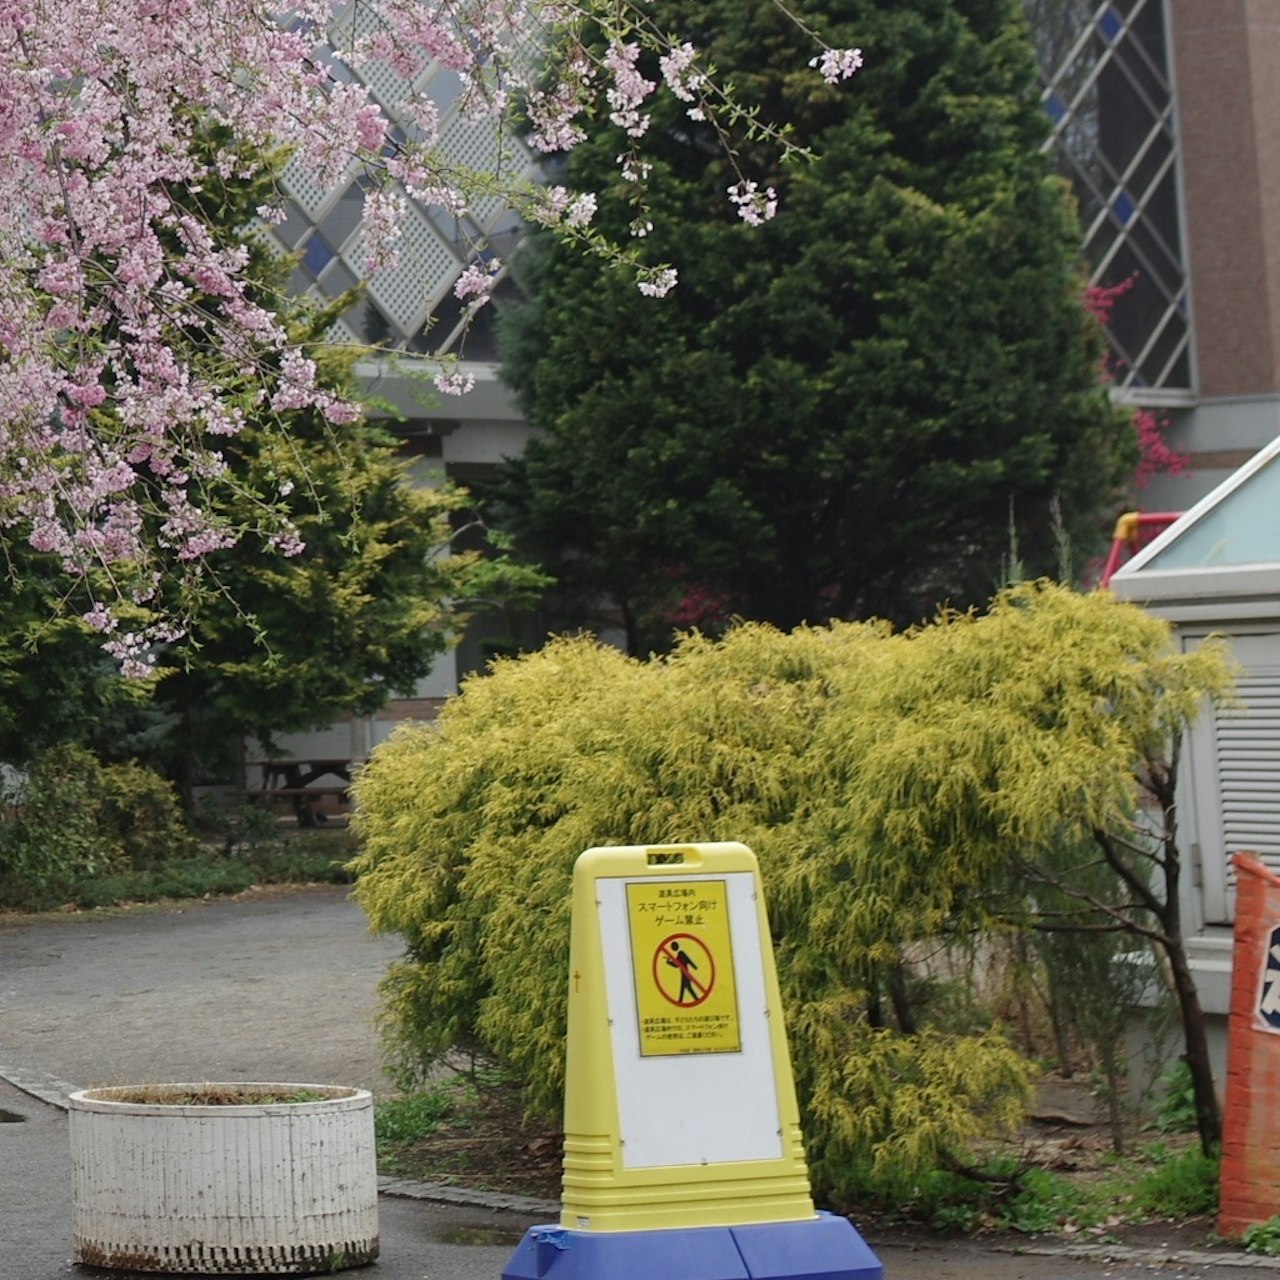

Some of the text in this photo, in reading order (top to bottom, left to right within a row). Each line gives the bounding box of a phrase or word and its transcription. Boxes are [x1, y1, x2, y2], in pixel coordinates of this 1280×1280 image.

[638, 900, 718, 912] スマートフォン向け
[654, 914, 705, 926] ゲーム禁止
